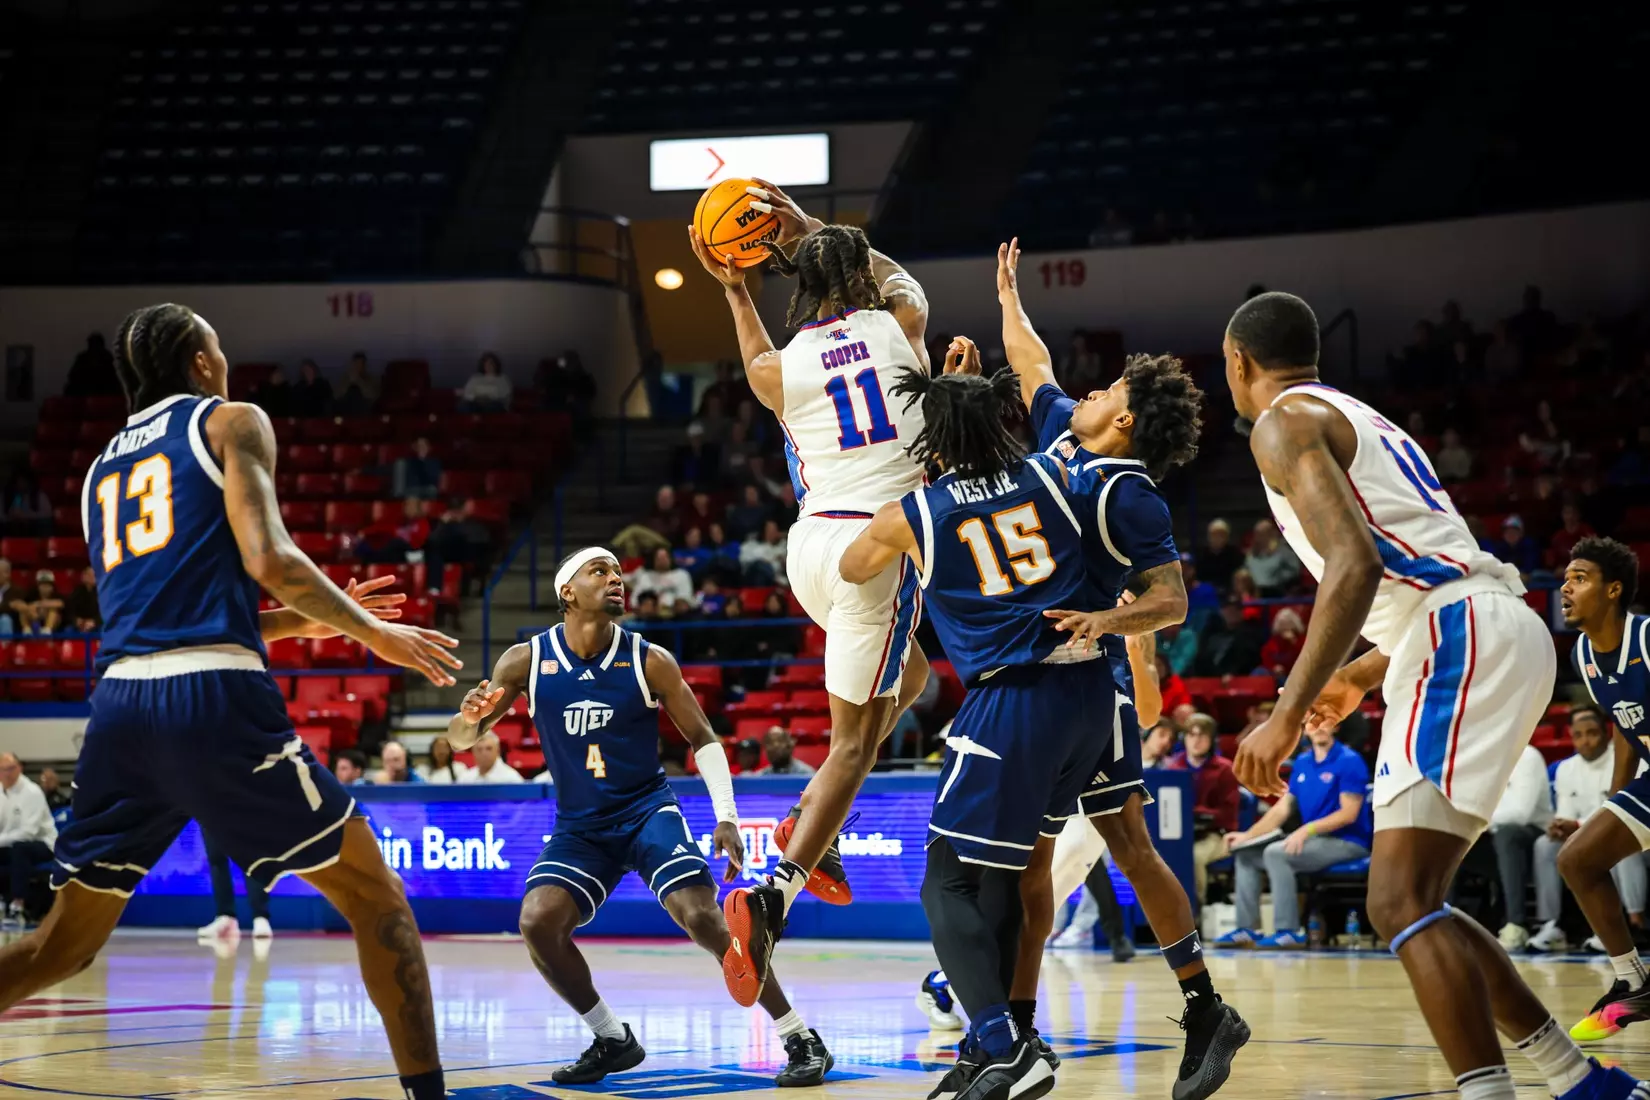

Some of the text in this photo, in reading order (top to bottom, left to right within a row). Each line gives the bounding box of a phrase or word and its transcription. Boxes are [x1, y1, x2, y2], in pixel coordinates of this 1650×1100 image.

[1037, 259, 1087, 289] 119
[327, 291, 374, 317] 118
[821, 340, 871, 370] COOPER
[824, 366, 898, 452] 11
[946, 470, 1019, 505] WEST JR.
[1379, 433, 1448, 513] 14
[96, 452, 175, 573] 13
[956, 501, 1056, 597] 15
[563, 700, 614, 737] UTEP
[1612, 700, 1645, 729] UTEP
[586, 743, 607, 778] 4
